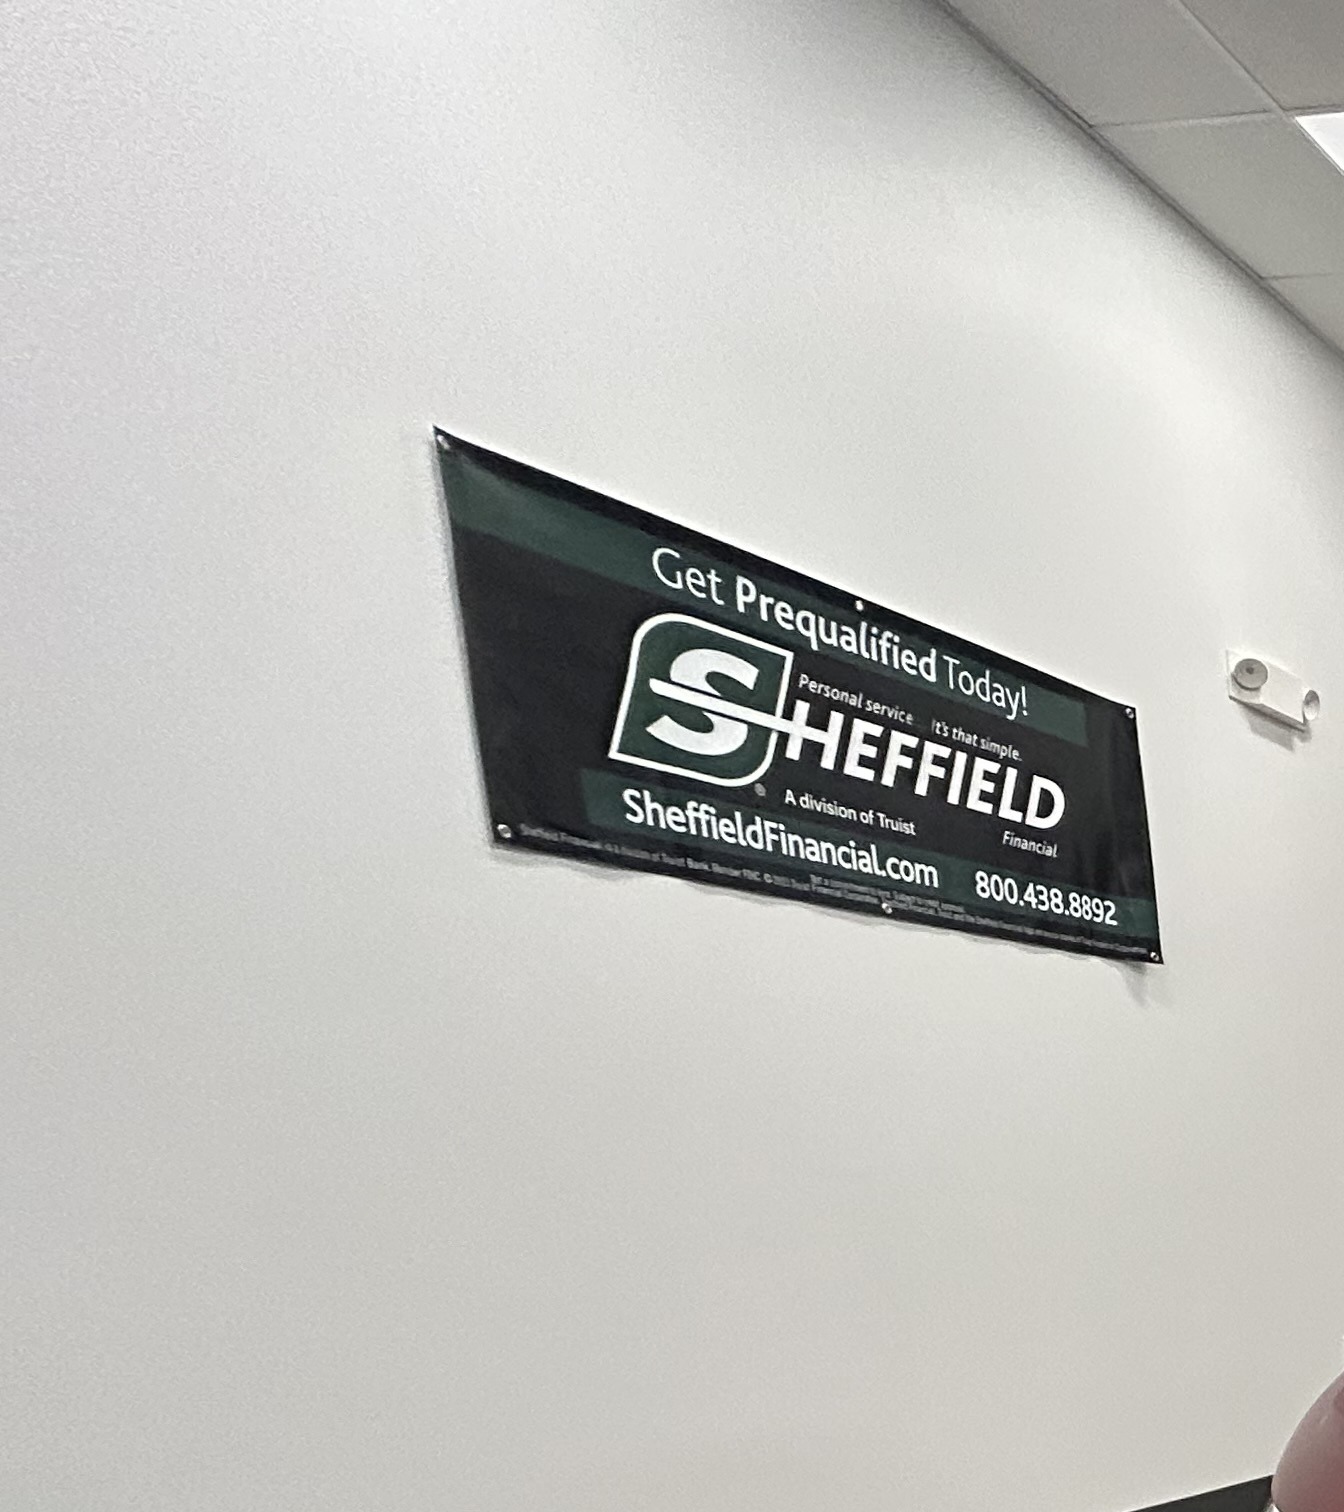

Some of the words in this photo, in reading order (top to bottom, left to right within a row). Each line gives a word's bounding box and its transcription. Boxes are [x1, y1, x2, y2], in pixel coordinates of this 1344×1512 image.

[652, 547, 725, 605] Get
[735, 574, 937, 682] Prequalified
[942, 655, 1028, 720] Today!
[799, 673, 863, 709] Personal
[952, 727, 978, 747] that
[980, 737, 1023, 762] simple.
[622, 788, 939, 888] SheffieldFinancial.com
[785, 789, 797, 806] A
[799, 792, 858, 821] division
[860, 809, 875, 825] of
[876, 812, 916, 836] Truist
[1002, 831, 1058, 858] Financial
[974, 870, 1118, 926] 800.438.8892
